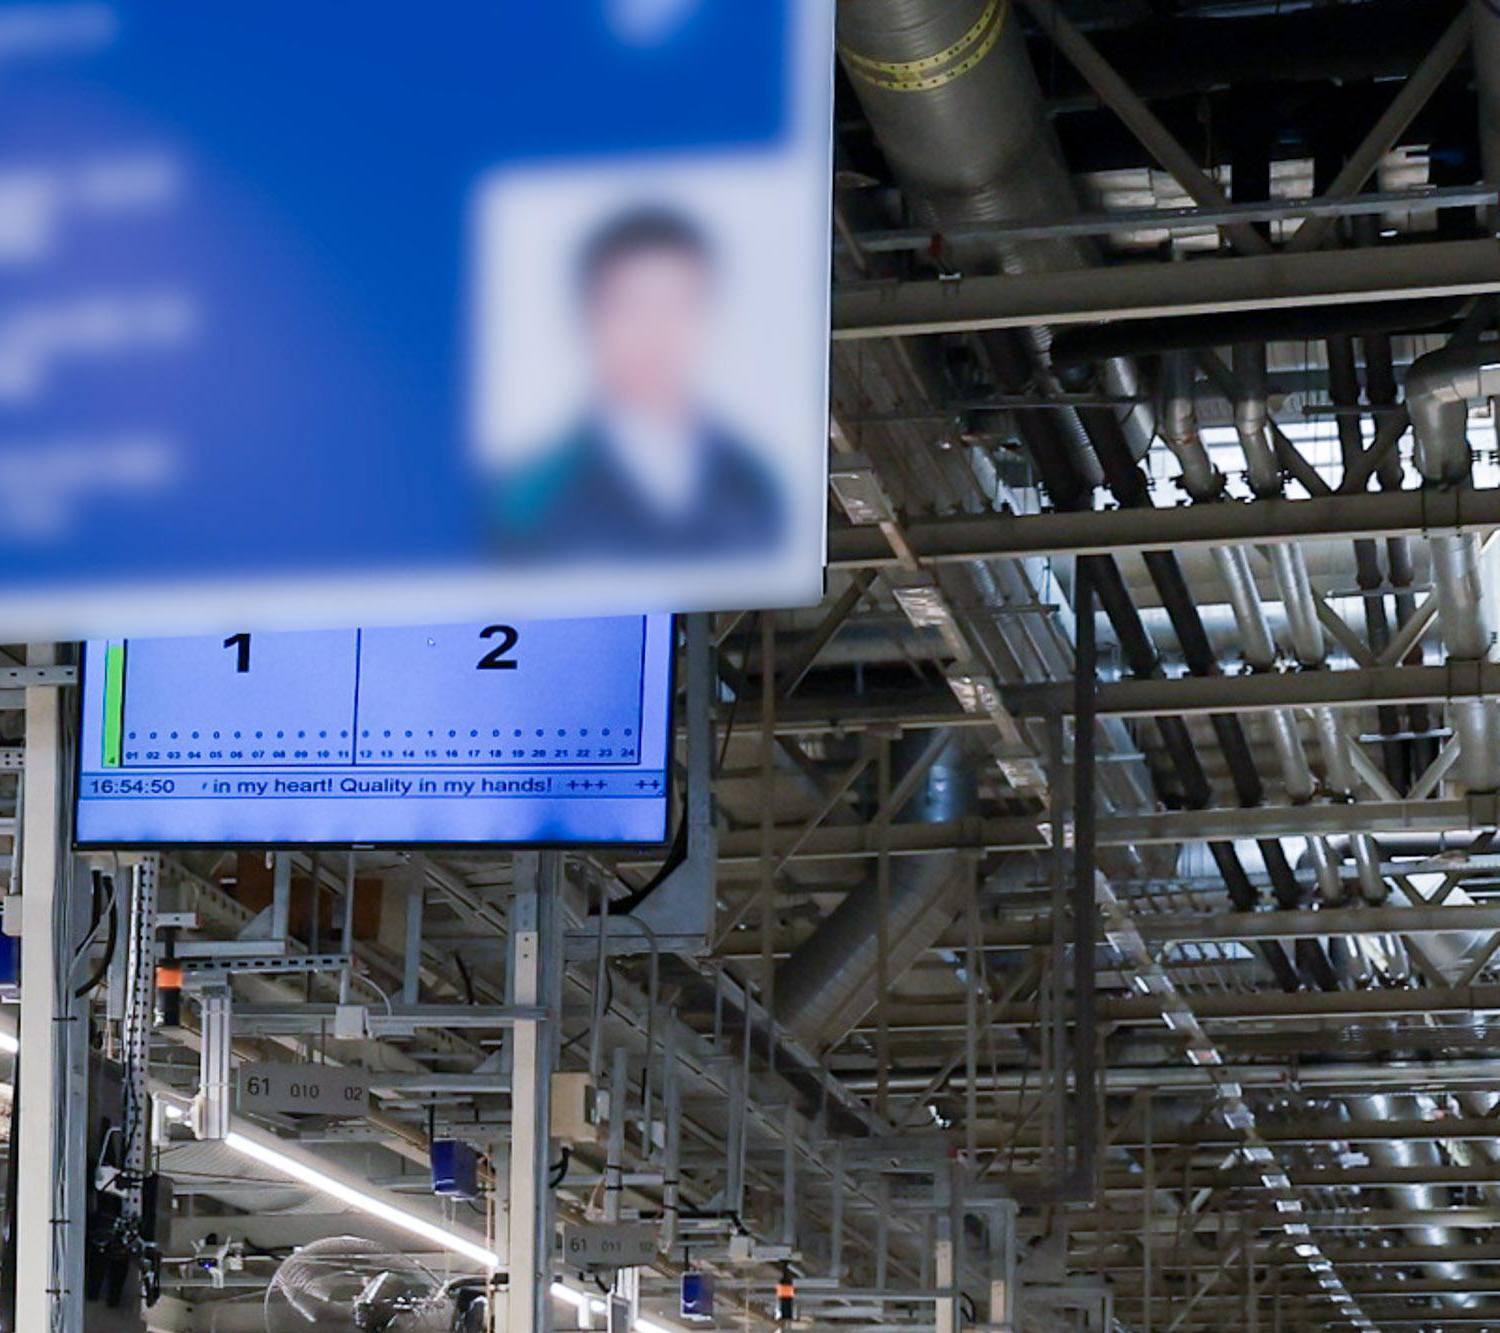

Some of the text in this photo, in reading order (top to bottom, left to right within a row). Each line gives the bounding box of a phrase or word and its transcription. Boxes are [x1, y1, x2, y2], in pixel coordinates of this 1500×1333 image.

[223, 633, 252, 673] 1
[475, 625, 520, 670] 2
[126, 748, 634, 760] 01 02 03 04 05 06 07 08 09 10 11 12 13 14 15 16 17 18 19 20 21 22 23 24
[90, 780, 175, 794] 16:54:50
[213, 778, 231, 793] in
[237, 782, 266, 796] my
[274, 778, 333, 793] heart!
[341, 778, 412, 796] Quality
[419, 778, 437, 793] in
[444, 781, 477, 796] my
[481, 777, 552, 792] hands!
[247, 1076, 363, 1101] 61 010 02
[570, 1237, 587, 1253] 61
